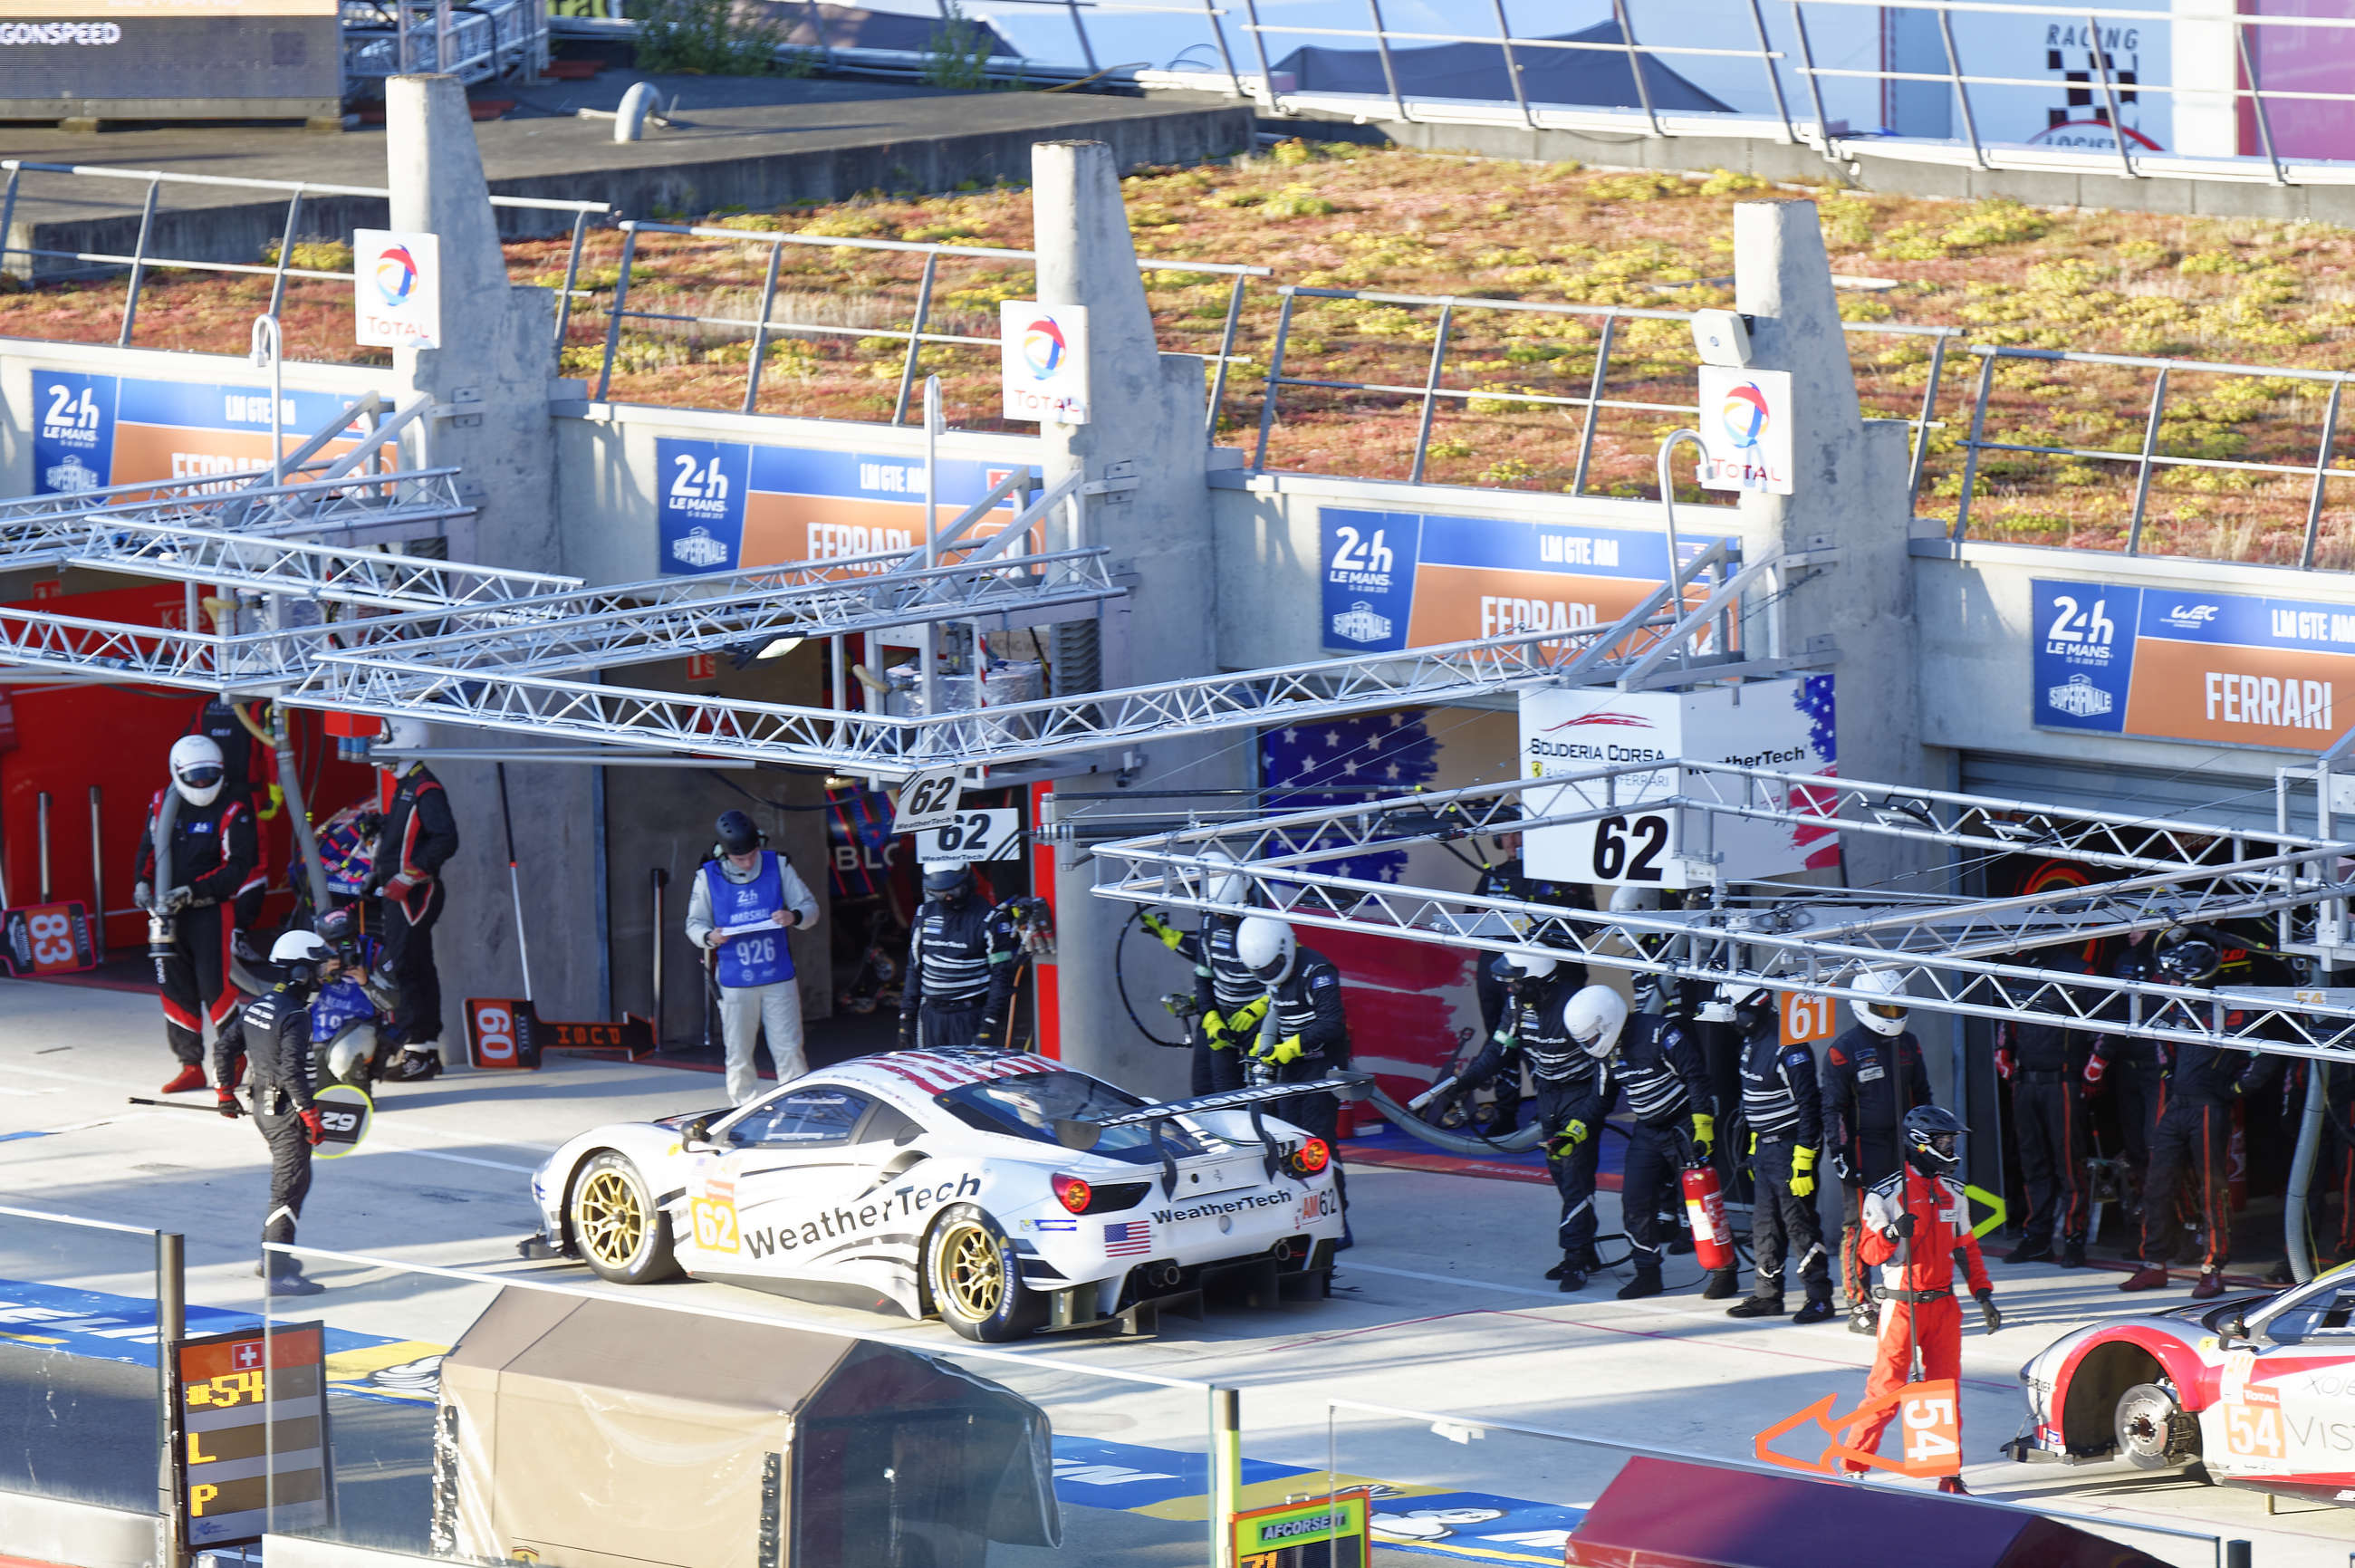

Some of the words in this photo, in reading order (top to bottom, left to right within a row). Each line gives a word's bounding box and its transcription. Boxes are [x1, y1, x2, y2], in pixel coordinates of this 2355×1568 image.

[366, 315, 430, 339] TOTAL
[43, 384, 100, 429] 24h
[1014, 389, 1081, 413] TOTAL
[43, 426, 61, 439] LE
[61, 428, 97, 442] MANS
[670, 454, 728, 499] 24h
[1709, 457, 1783, 482] TOTAL
[668, 496, 687, 510] LE
[687, 498, 726, 513] MANS
[1331, 526, 1393, 572] 24h
[1541, 534, 1562, 563] LM
[1329, 570, 1349, 583] LE
[1349, 572, 1390, 587] MANS
[2048, 595, 2114, 645] 24h
[2272, 609, 2297, 639] LM
[2299, 611, 2328, 641] GTE
[2046, 641, 2066, 655] LE
[2066, 643, 2110, 659] MANS
[2205, 671, 2332, 731] FERRARI
[1531, 738, 1601, 760] SCUDERIA
[1608, 744, 1666, 764] CORSA
[909, 776, 956, 816] 62
[937, 813, 992, 851] 62
[1593, 815, 1669, 882] 62
[30, 913, 73, 965] 83
[735, 937, 776, 967] 926
[477, 1007, 514, 1060] 60
[1789, 993, 1828, 1040] 61
[744, 1171, 982, 1260] WeatherTech
[1152, 1189, 1292, 1224] WeatherTech
[1302, 1194, 1319, 1220] AM
[1319, 1188, 1337, 1217] 62
[695, 1202, 736, 1251] 62
[2244, 1387, 2280, 1403] TOTAL
[1904, 1399, 1956, 1462] 54
[2230, 1405, 2281, 1457] 54
[187, 1432, 216, 1465] L
[190, 1484, 218, 1517] P
